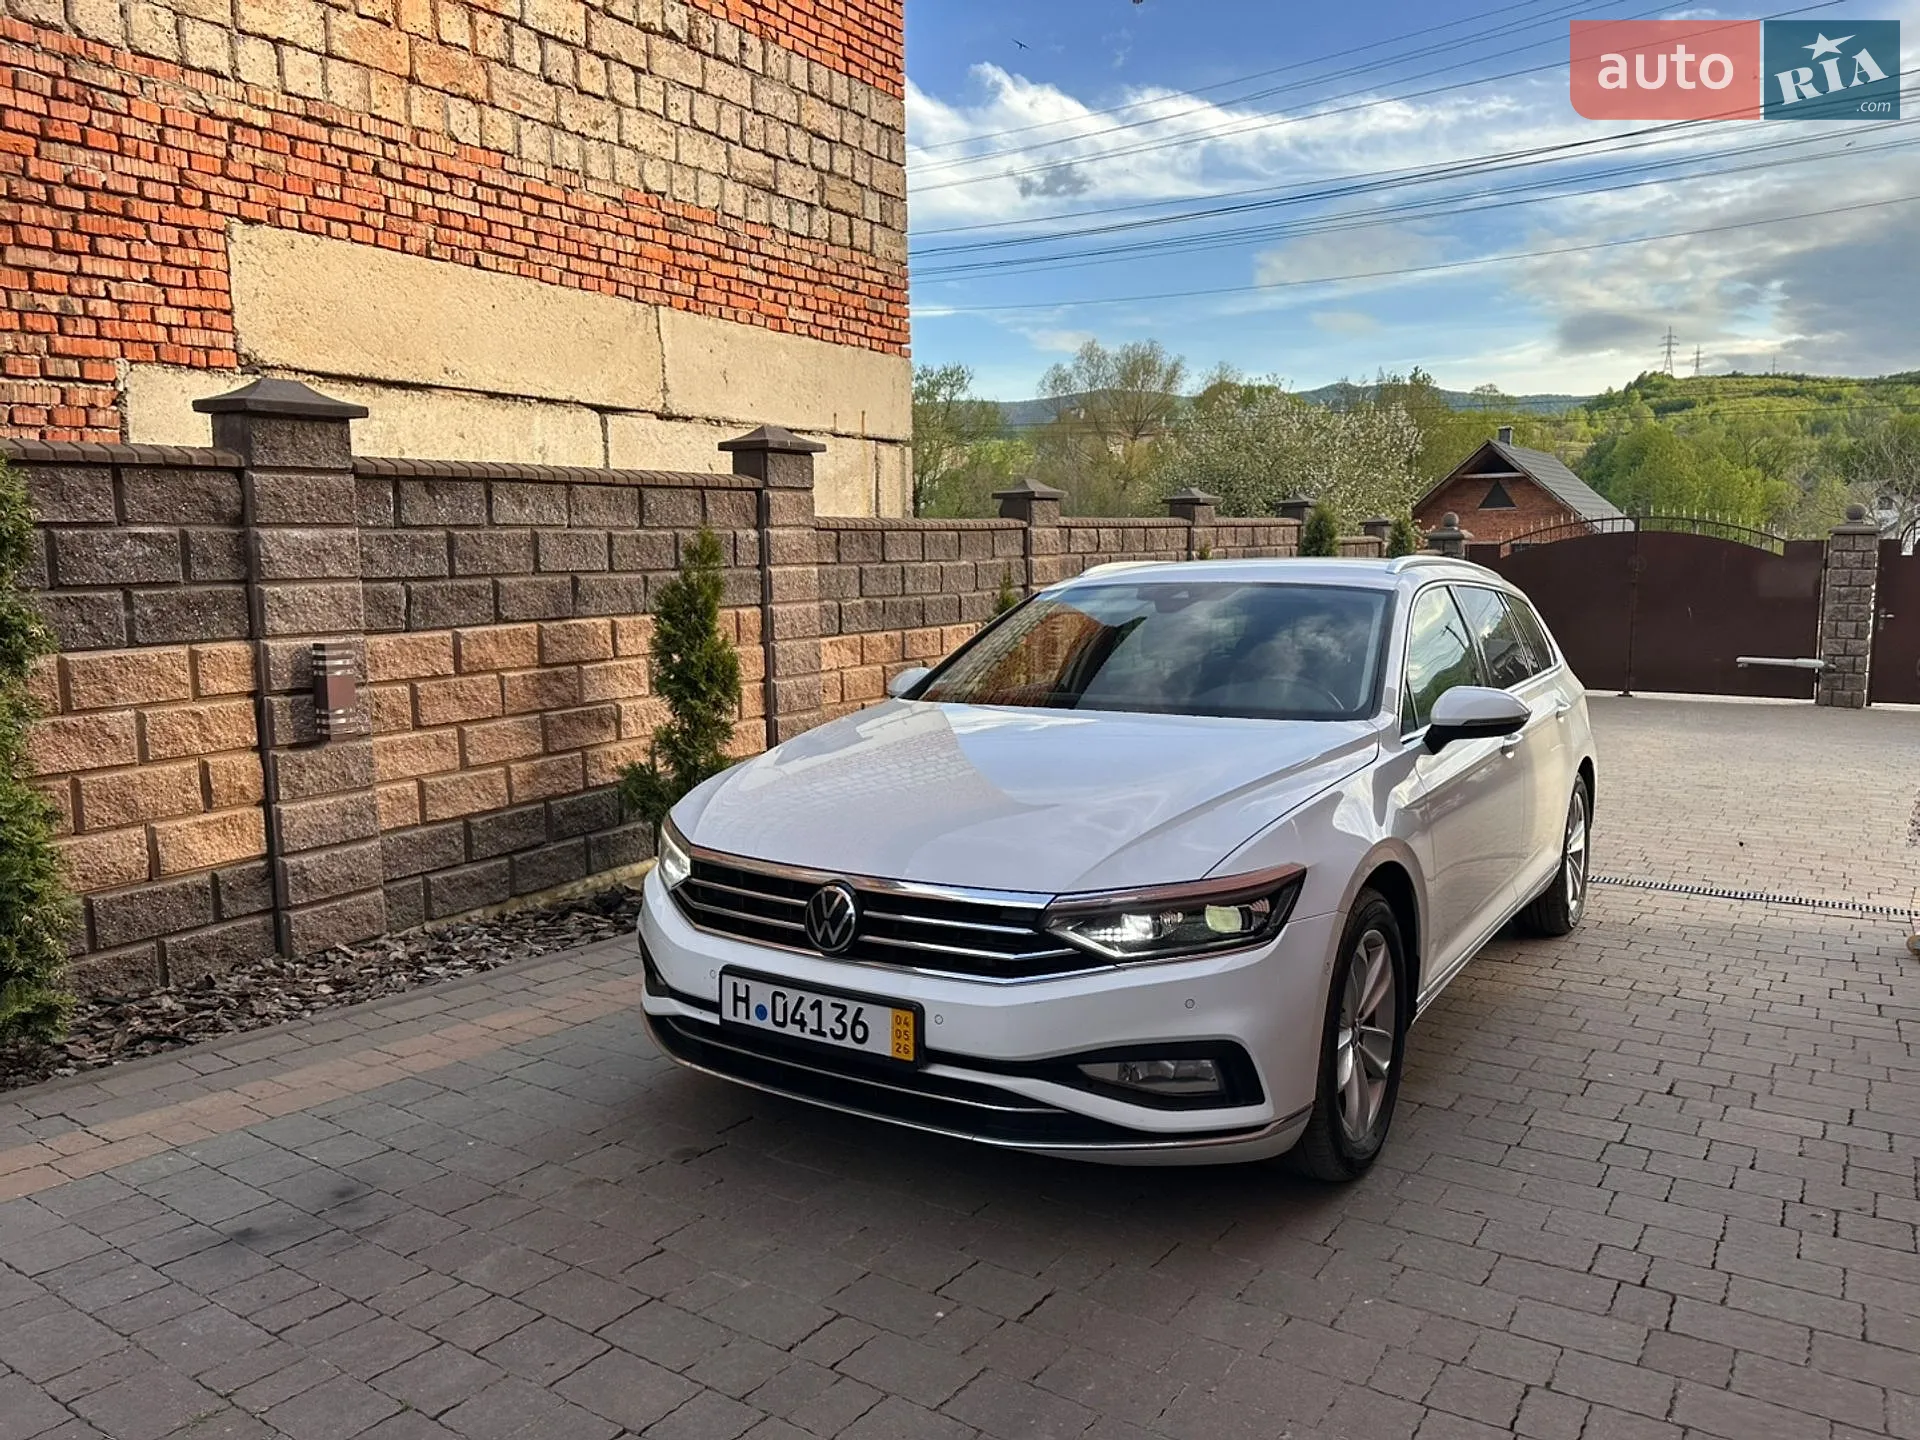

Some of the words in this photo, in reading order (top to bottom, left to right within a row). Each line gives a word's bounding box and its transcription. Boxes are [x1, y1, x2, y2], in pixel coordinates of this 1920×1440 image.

[807, 887, 855, 949] VW
[733, 981, 750, 1020] H
[771, 990, 869, 1044] 04136
[895, 1014, 909, 1027] 04
[895, 1042, 910, 1055] 26
